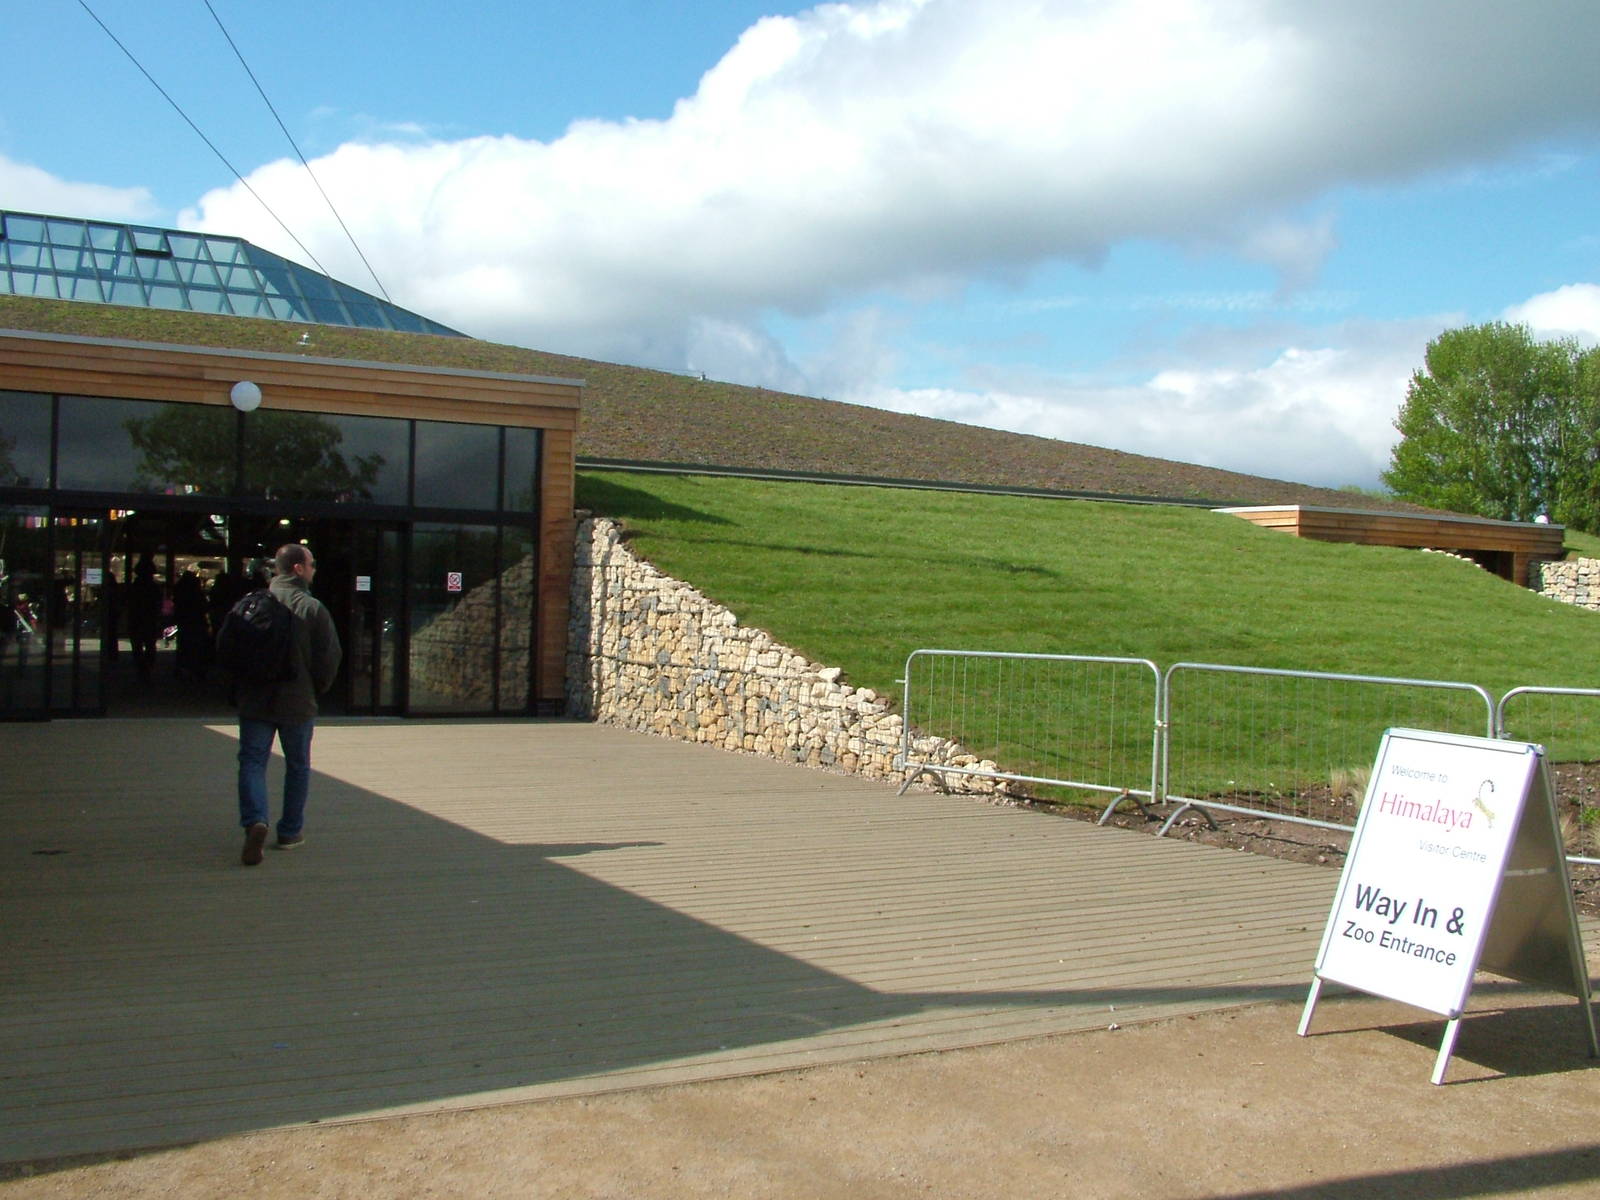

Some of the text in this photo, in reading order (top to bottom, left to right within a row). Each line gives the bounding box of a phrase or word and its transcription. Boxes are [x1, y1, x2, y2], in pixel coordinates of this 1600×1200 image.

[1391, 764, 1448, 784] Welcome to
[1380, 792, 1473, 832] Himalaya
[1418, 839, 1487, 864] Visitor Centre
[1355, 883, 1465, 936] Way In &
[1342, 920, 1457, 967] Zoo Entrance
